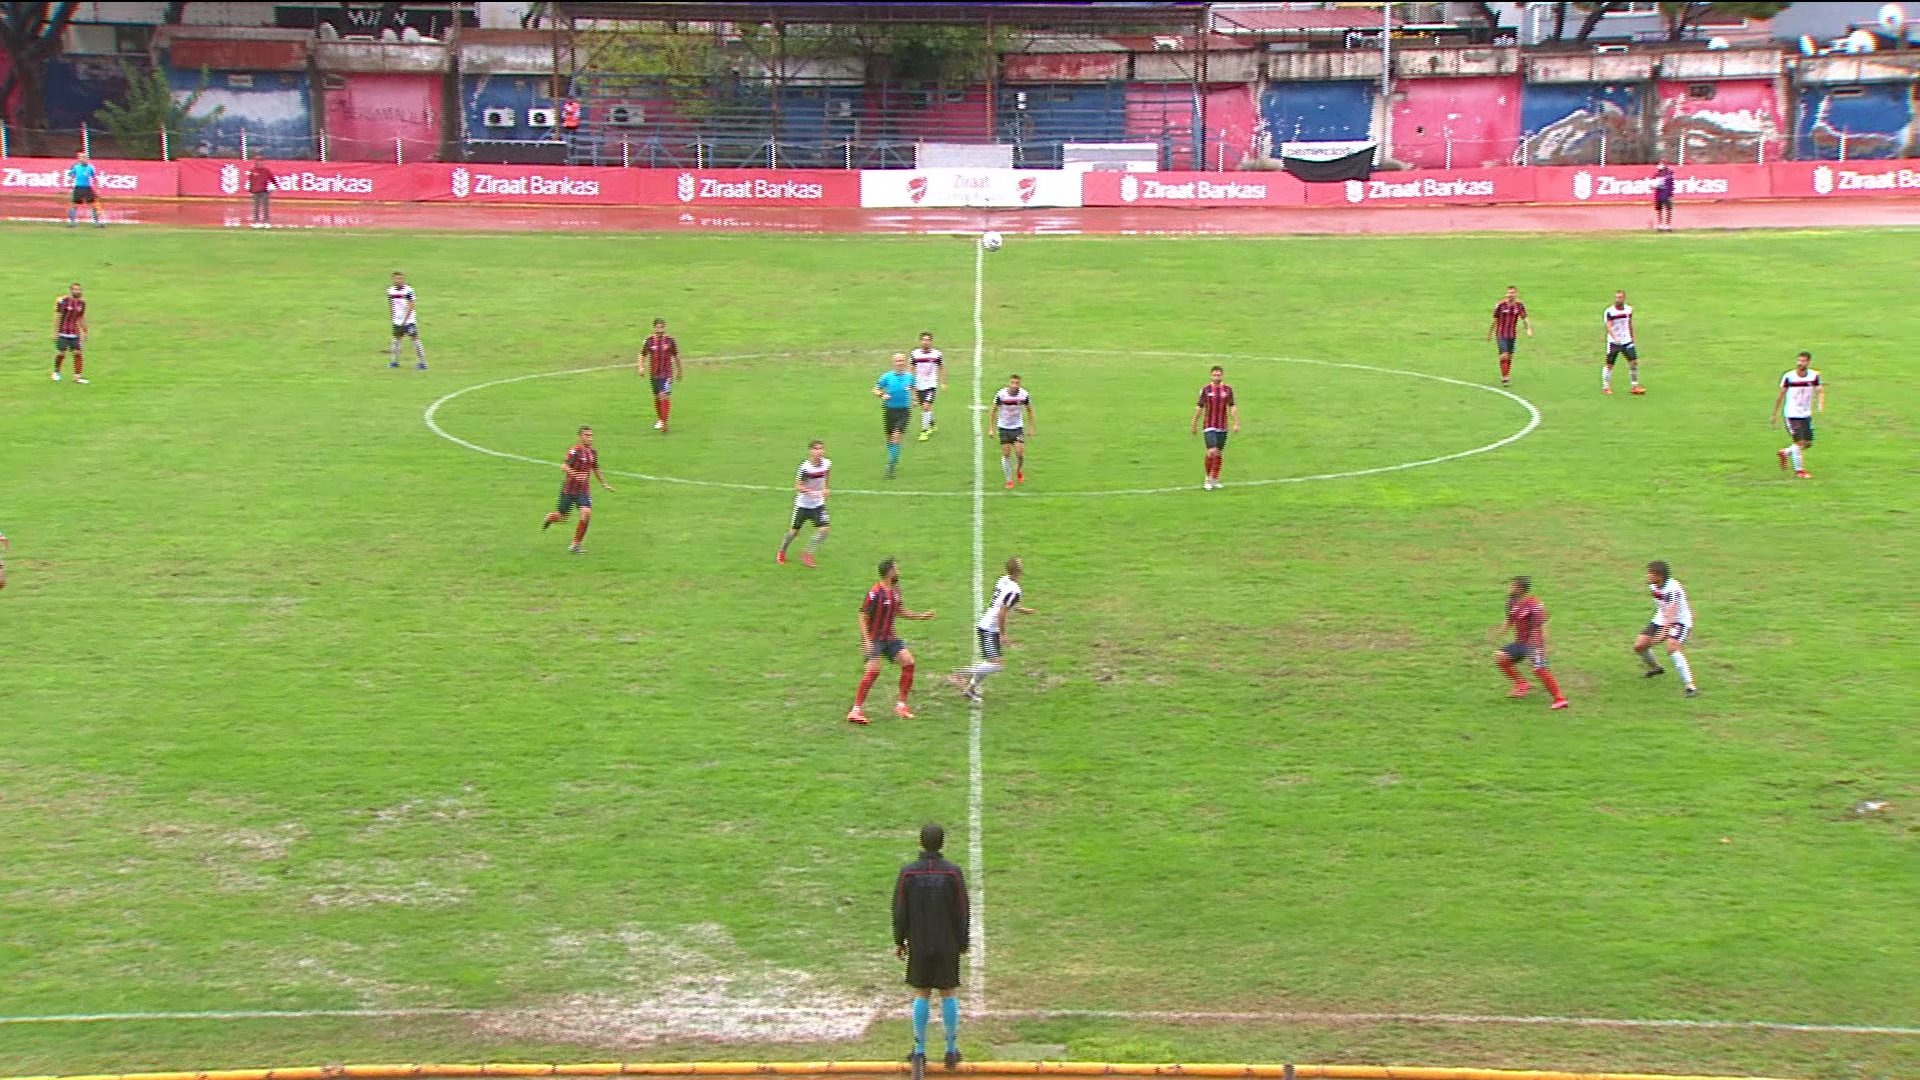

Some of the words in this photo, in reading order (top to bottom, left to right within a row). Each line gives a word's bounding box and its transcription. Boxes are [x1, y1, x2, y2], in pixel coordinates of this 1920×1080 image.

[1, 167, 60, 187] Ziraat
[63, 168, 138, 189] Bkası
[301, 172, 373, 193] Bankası
[474, 174, 528, 194] Ziraat
[530, 175, 600, 196] Bankası
[1367, 180, 1422, 198] Ziraat
[1422, 178, 1494, 197] Bankası
[1595, 176, 1651, 195] Ziraat
[1837, 171, 1896, 190] Ziraat
[699, 178, 753, 197] Ziraat
[755, 179, 823, 199] Bankası
[1142, 180, 1196, 199] Ziraat
[1197, 181, 1266, 199] Bankası
